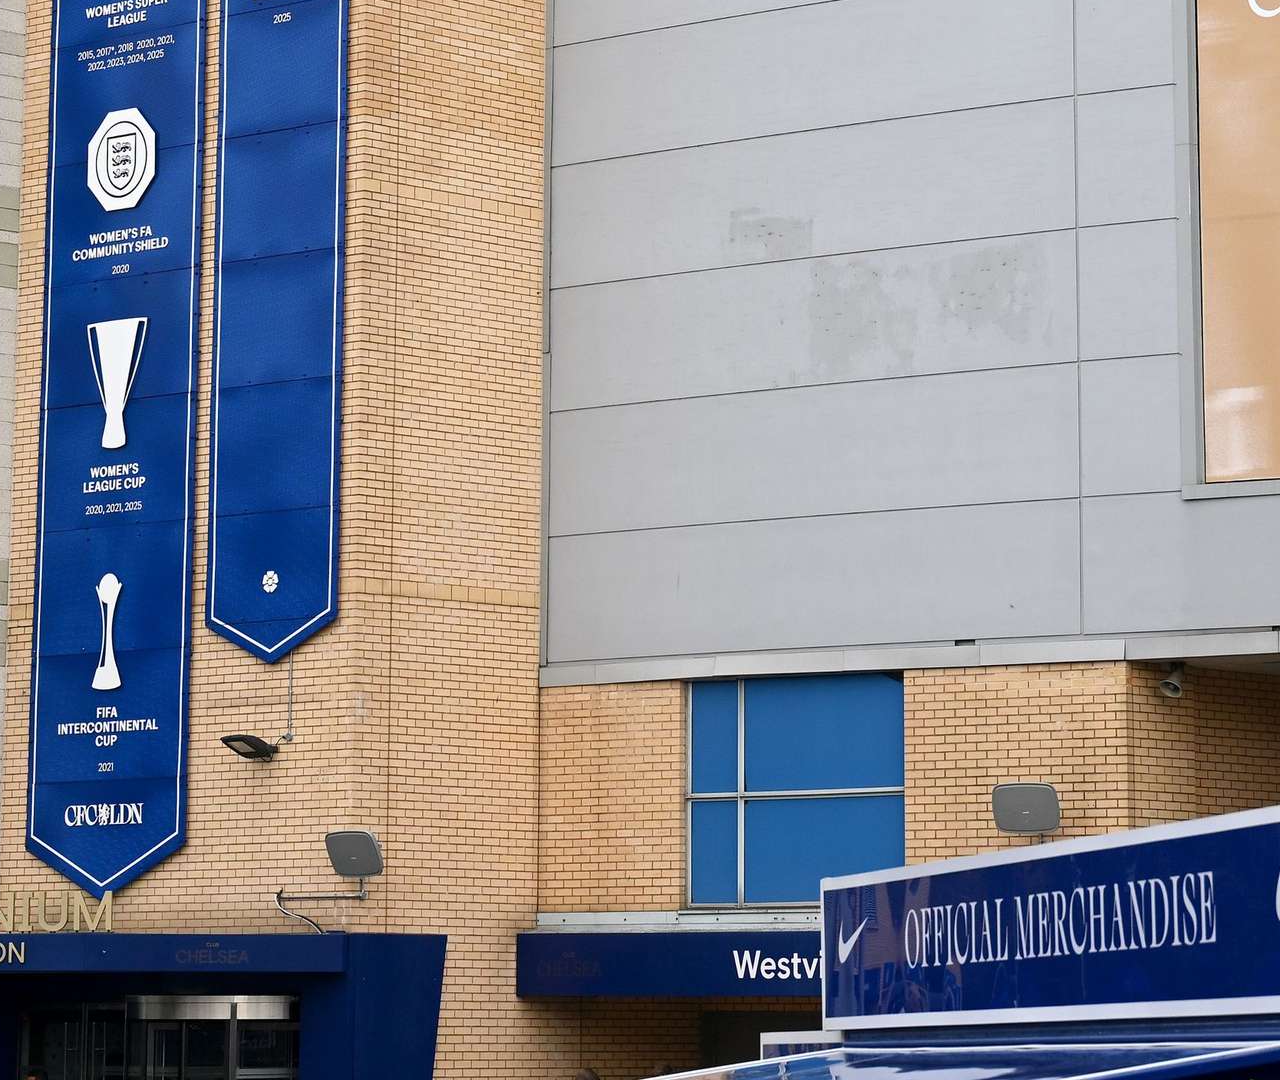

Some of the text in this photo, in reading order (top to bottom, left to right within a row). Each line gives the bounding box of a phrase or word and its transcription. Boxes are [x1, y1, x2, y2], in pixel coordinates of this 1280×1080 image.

[86, 0, 133, 18] WOMEN'S
[108, 11, 146, 28] LEAGUE
[273, 13, 291, 24] 2025
[147, 49, 164, 60] 2025
[90, 225, 152, 245] WOMEN'S FA
[73, 237, 168, 261] COMMUNITY SHIELD
[112, 264, 129, 274] 2020
[90, 463, 139, 478] WOMEN'S
[83, 477, 145, 493] LEAGUE CUP
[125, 501, 142, 511] 2025
[96, 706, 117, 718] FIFA
[58, 719, 158, 735] INTERCONTINENTAL
[95, 735, 117, 747] CUP
[98, 762, 113, 772] 2021
[904, 871, 1217, 969] OFFICIAL MERCHANDISE
[175, 950, 249, 963] CHELSEA
